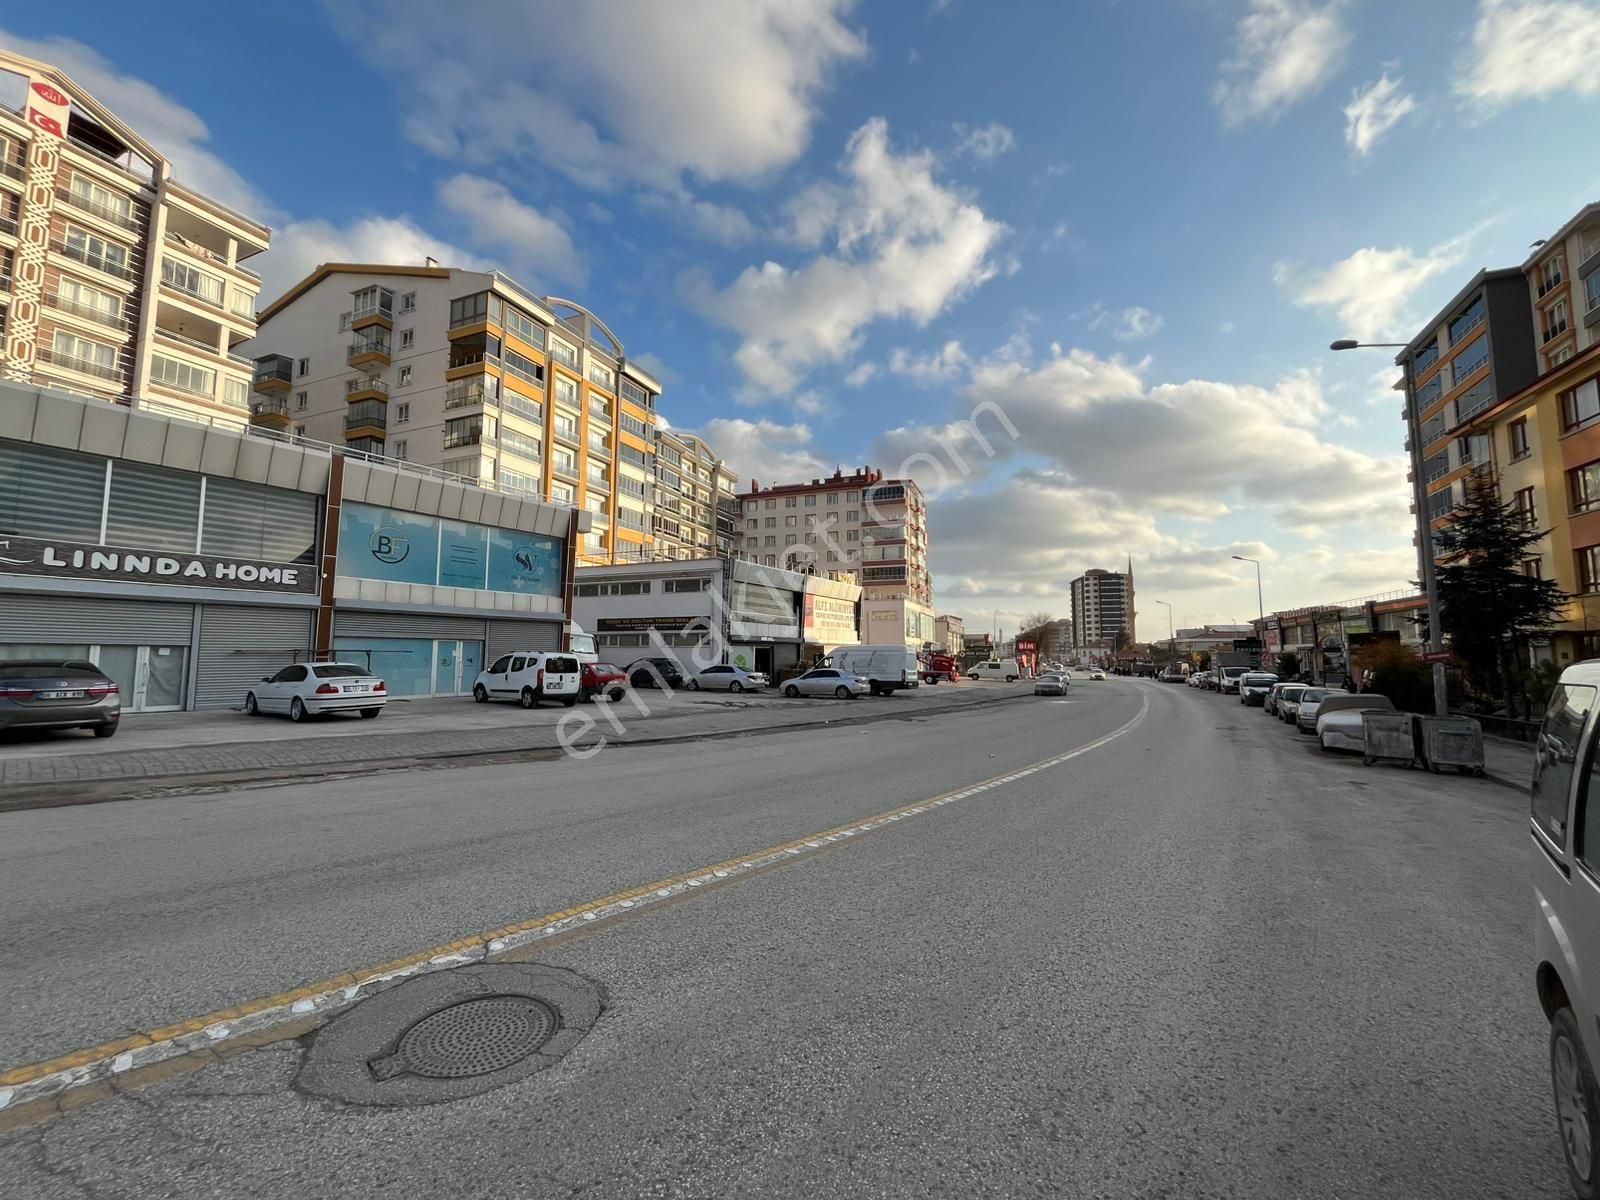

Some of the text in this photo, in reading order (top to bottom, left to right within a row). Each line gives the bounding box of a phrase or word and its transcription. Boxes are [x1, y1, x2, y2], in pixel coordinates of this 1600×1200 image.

[42, 546, 298, 586] LINNDA HOME
[1018, 641, 1034, 650] BİM
